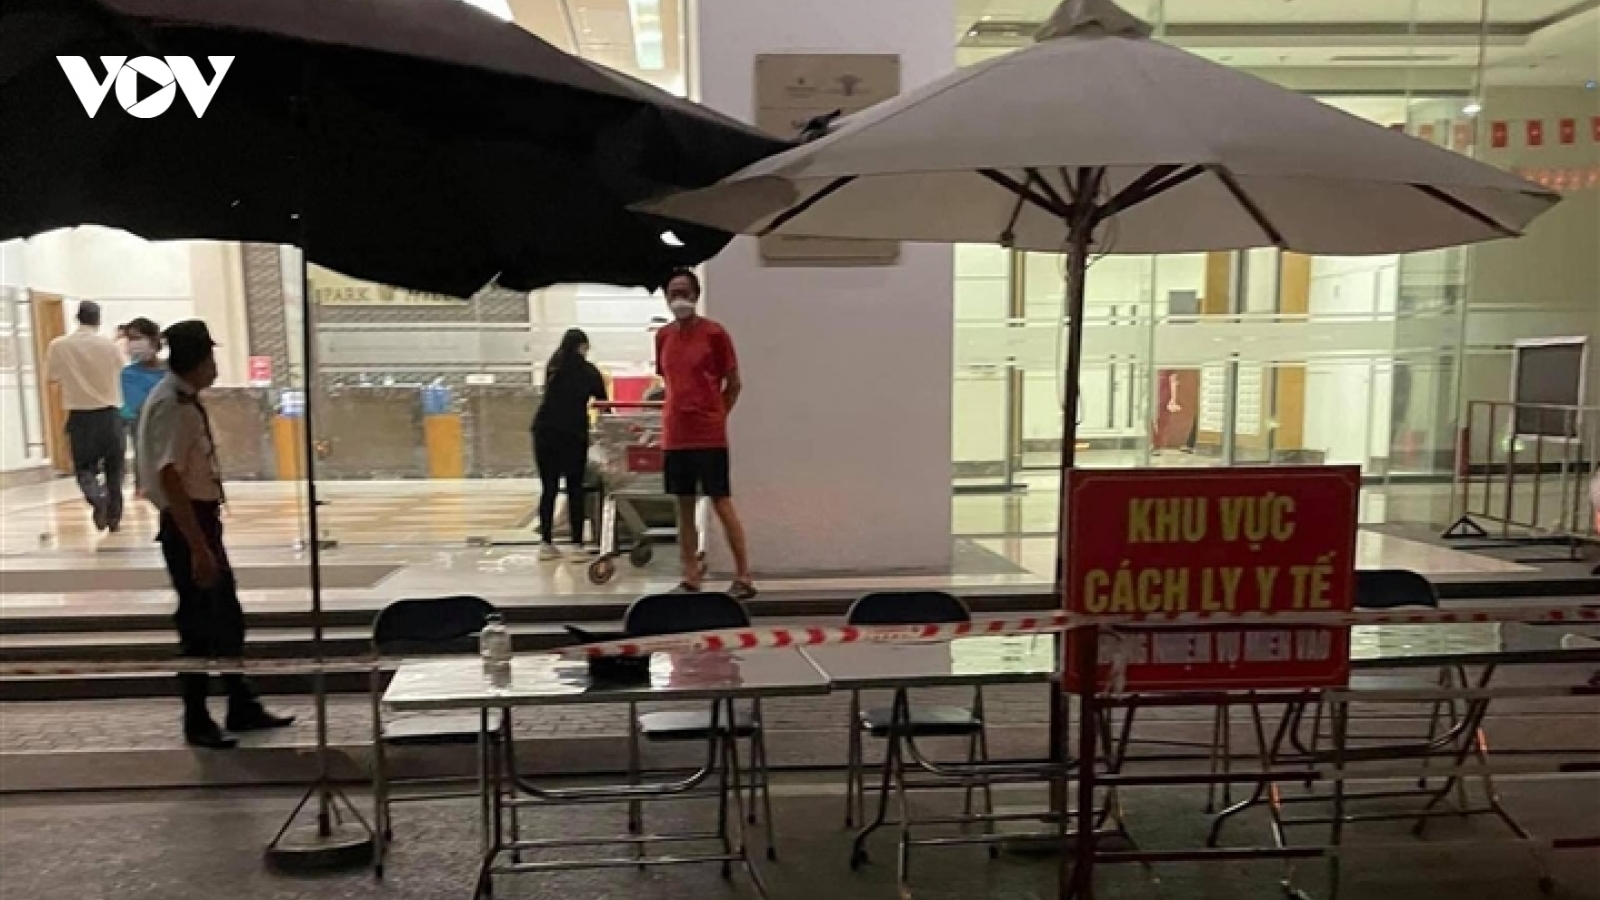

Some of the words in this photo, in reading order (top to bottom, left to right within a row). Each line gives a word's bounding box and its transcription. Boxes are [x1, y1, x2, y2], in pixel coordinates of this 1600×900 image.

[1128, 497, 1208, 543] KHU
[1219, 491, 1296, 552] VỰC
[1083, 559, 1189, 613] CÁCH
[1201, 566, 1243, 611] LY
[1255, 566, 1279, 611] Y
[1289, 551, 1337, 609] TẾ
